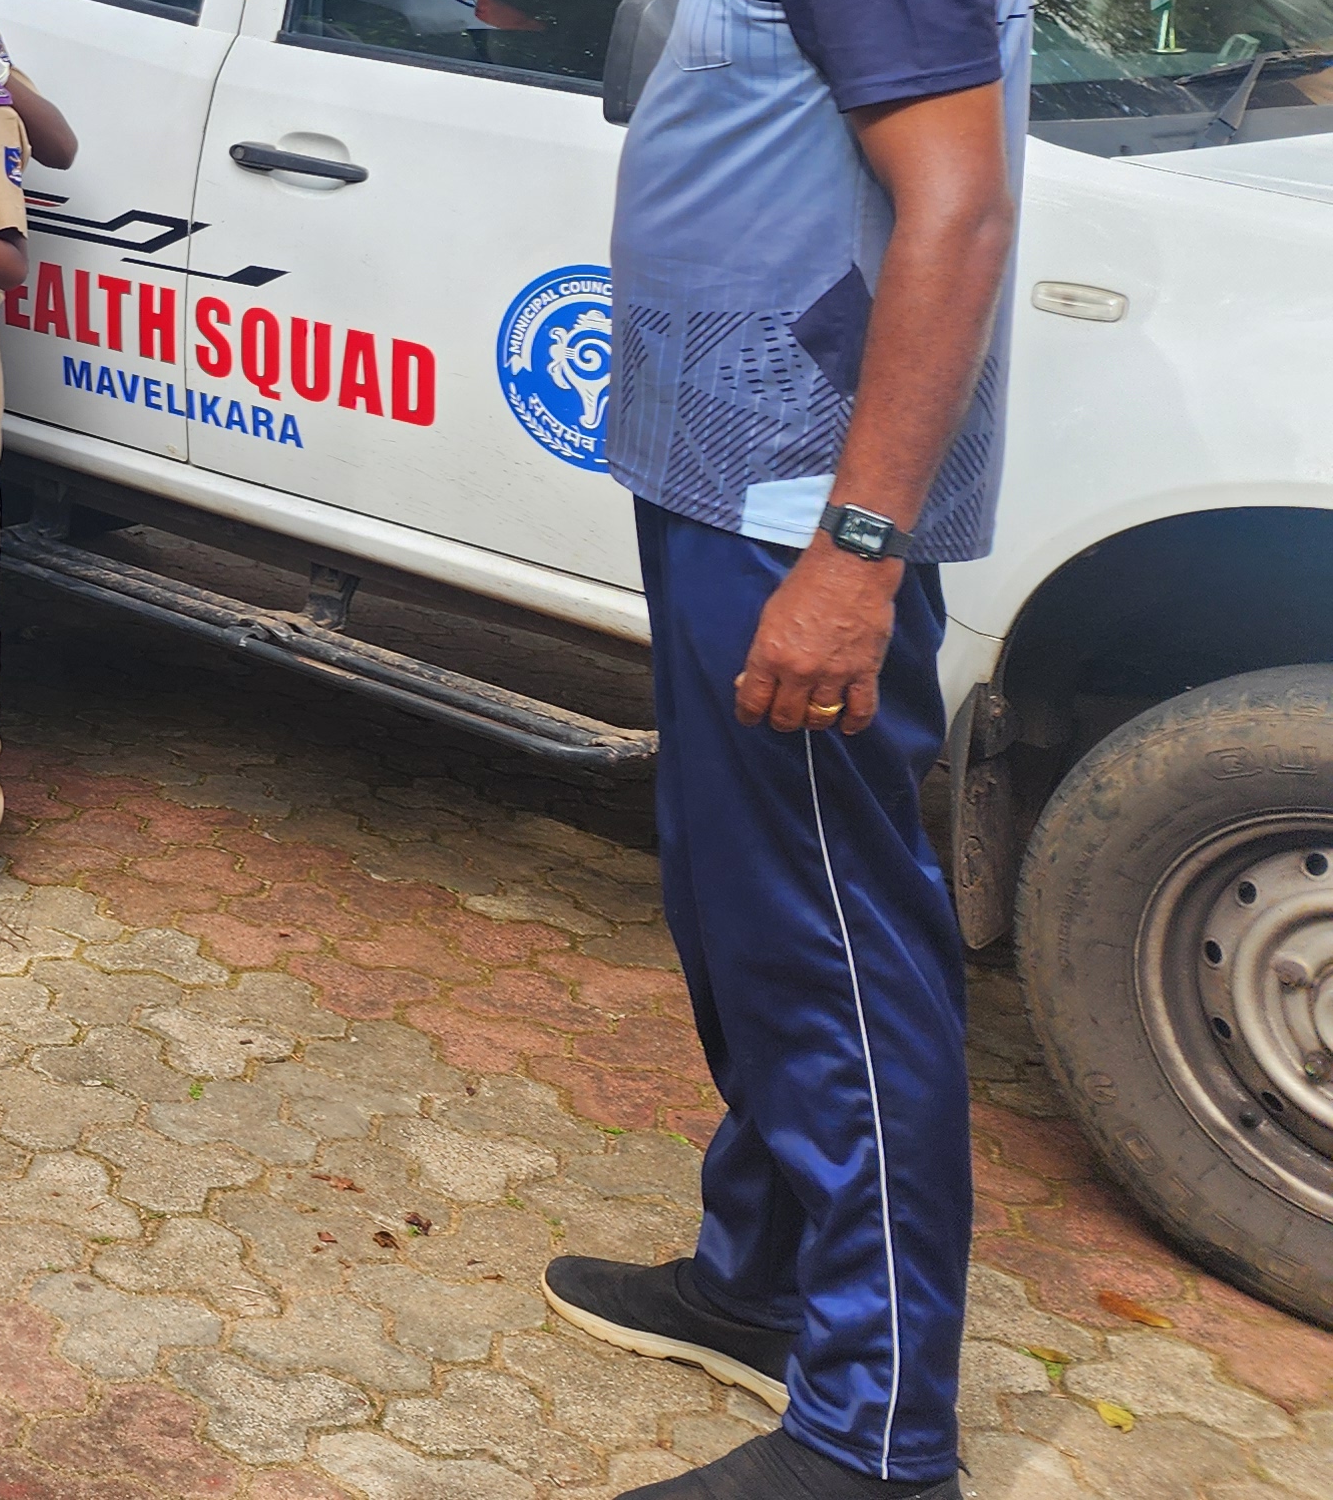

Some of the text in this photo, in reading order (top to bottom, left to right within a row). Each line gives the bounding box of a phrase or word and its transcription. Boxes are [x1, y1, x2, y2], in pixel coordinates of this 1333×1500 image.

[195, 296, 436, 427] SQUAD
[508, 280, 613, 355] MUNICIPAL COUNC
[62, 355, 305, 450] MAVELIKARA
